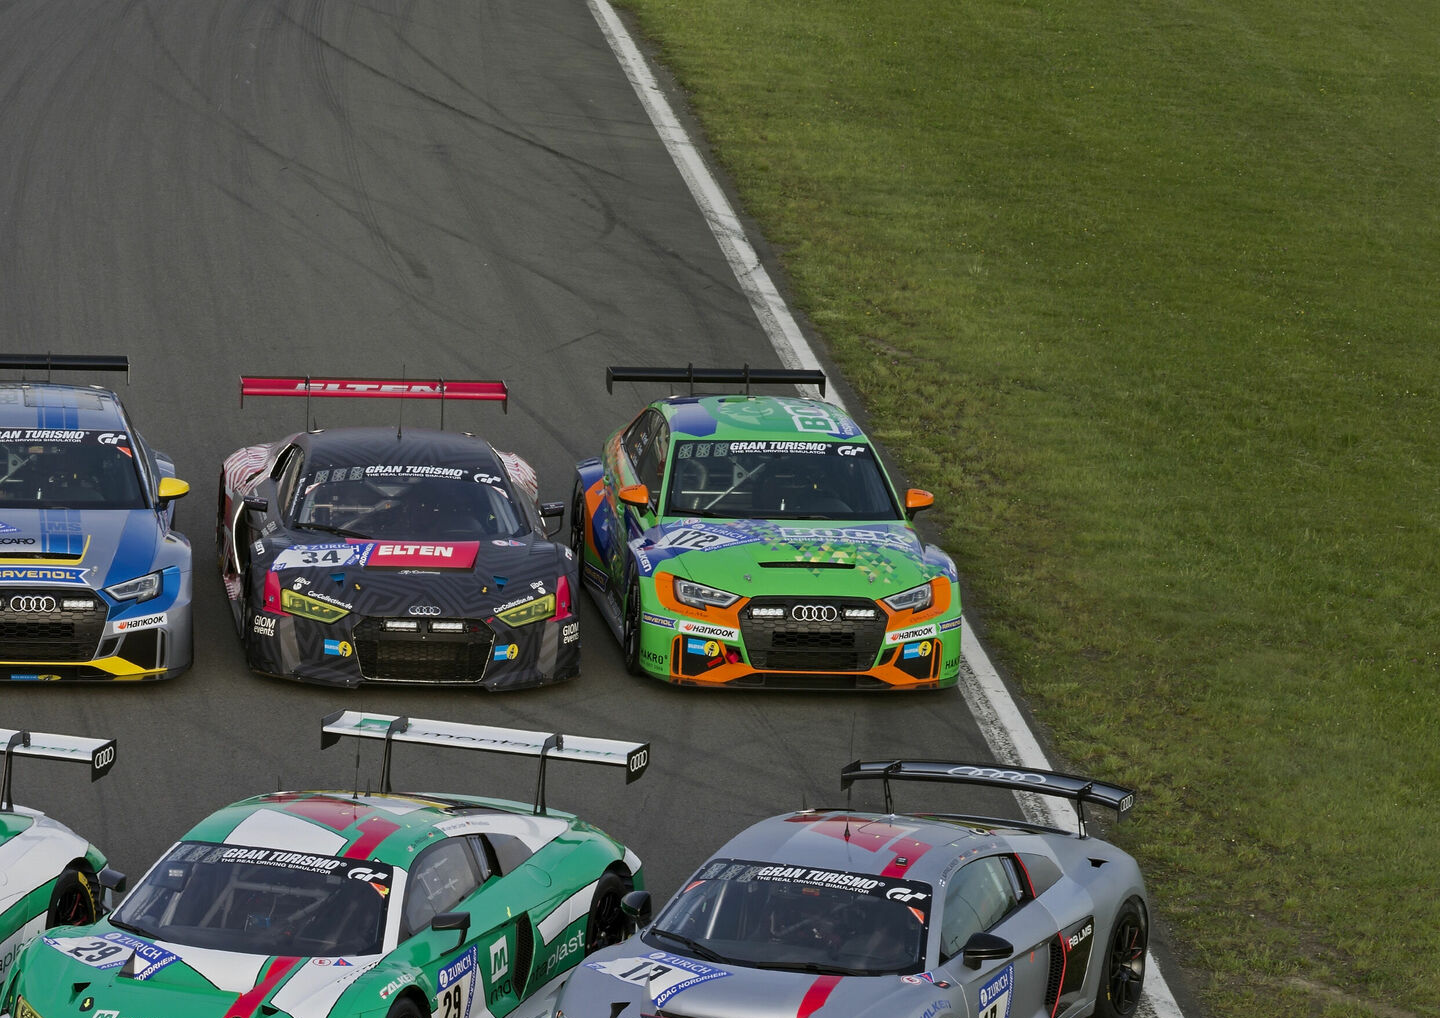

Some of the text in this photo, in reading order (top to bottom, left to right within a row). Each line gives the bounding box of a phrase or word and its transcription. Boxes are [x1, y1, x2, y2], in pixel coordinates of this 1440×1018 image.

[294, 383, 447, 393] ELTEN
[25, 430, 85, 440] TURISMO
[729, 442, 828, 451] GRAN TURISMO
[365, 465, 464, 477] GRAN TURISMO
[668, 529, 720, 548] 172
[704, 525, 748, 540] ZURICH
[311, 543, 359, 552] ZURICH
[378, 545, 454, 557] ELTEN
[301, 550, 341, 564] 34
[221, 848, 341, 871] GRAN TURISMO
[256, 860, 286, 869] DRIVING
[287, 863, 331, 875] SIMULATOR
[758, 866, 879, 890] GRAN TURISMO
[793, 878, 824, 887] DRIVING
[825, 882, 870, 895] SIMULATOR
[67, 941, 123, 962] 29
[118, 935, 163, 960] ZURICH
[448, 953, 472, 981] ZURICH
[618, 961, 673, 982] 17
[664, 953, 711, 974] ZURICH
[657, 971, 727, 1006] ADAC NORDRHEIN
[986, 973, 1008, 1000] ZURICH
